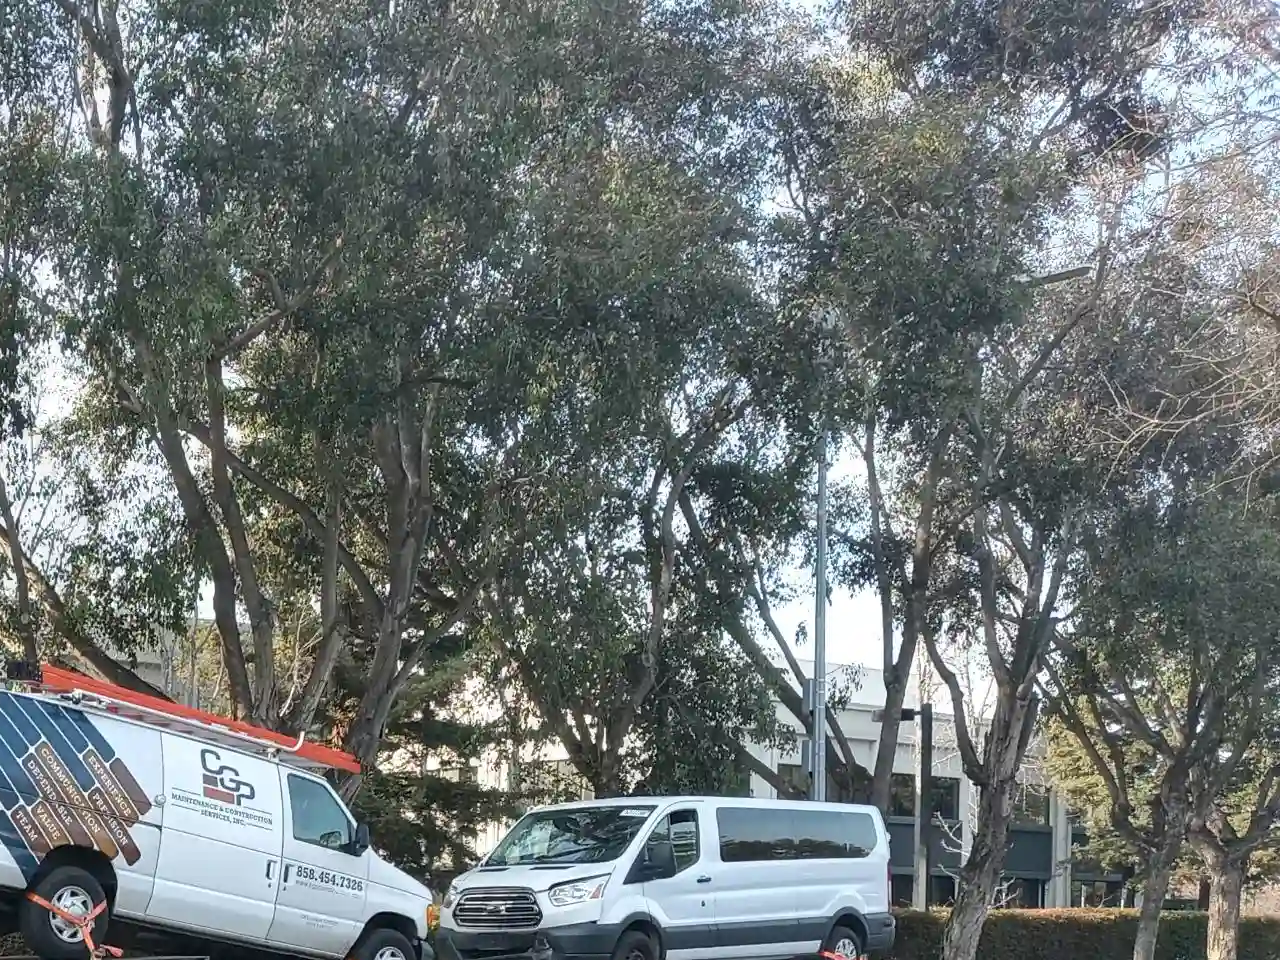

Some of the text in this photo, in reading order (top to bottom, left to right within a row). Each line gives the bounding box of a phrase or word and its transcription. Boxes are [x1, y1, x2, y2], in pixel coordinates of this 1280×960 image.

[88, 756, 131, 817] EXPERIENCE
[15, 811, 39, 841] TEAM
[36, 805, 61, 840] VALUE
[171, 793, 219, 811] MAINTENANCE
[224, 807, 273, 826] CONSTRUCTION
[296, 866, 363, 891] 858.454.7326
